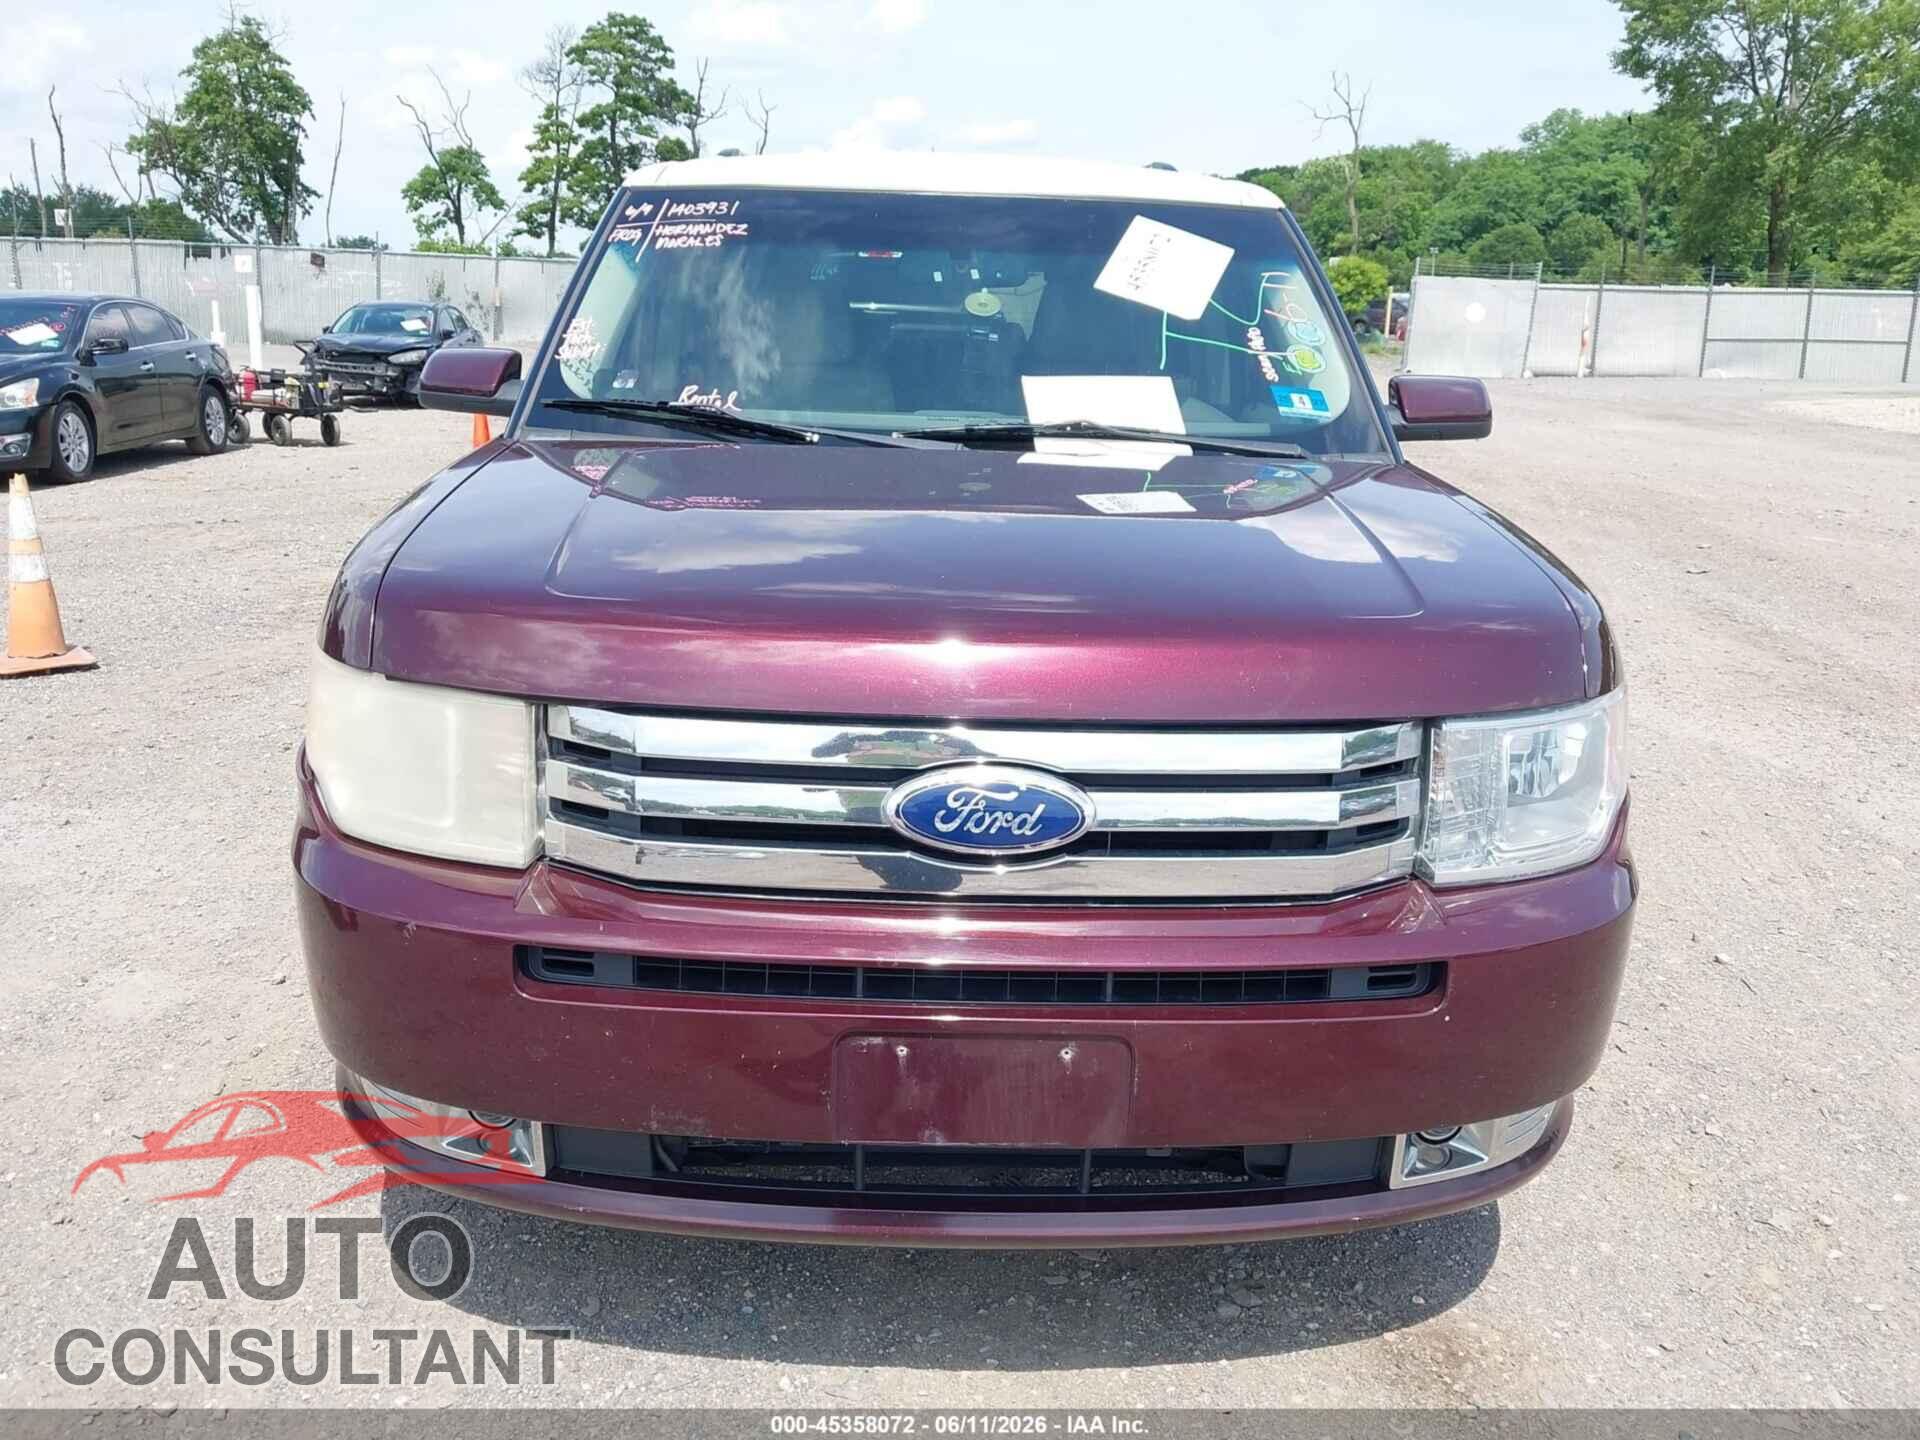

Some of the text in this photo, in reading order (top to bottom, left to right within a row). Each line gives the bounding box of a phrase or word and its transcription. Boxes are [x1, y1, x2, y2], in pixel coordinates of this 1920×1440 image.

[655, 223, 749, 236] HERNANDEZ
[668, 384, 743, 411] Rental
[934, 787, 1046, 836] Ford
